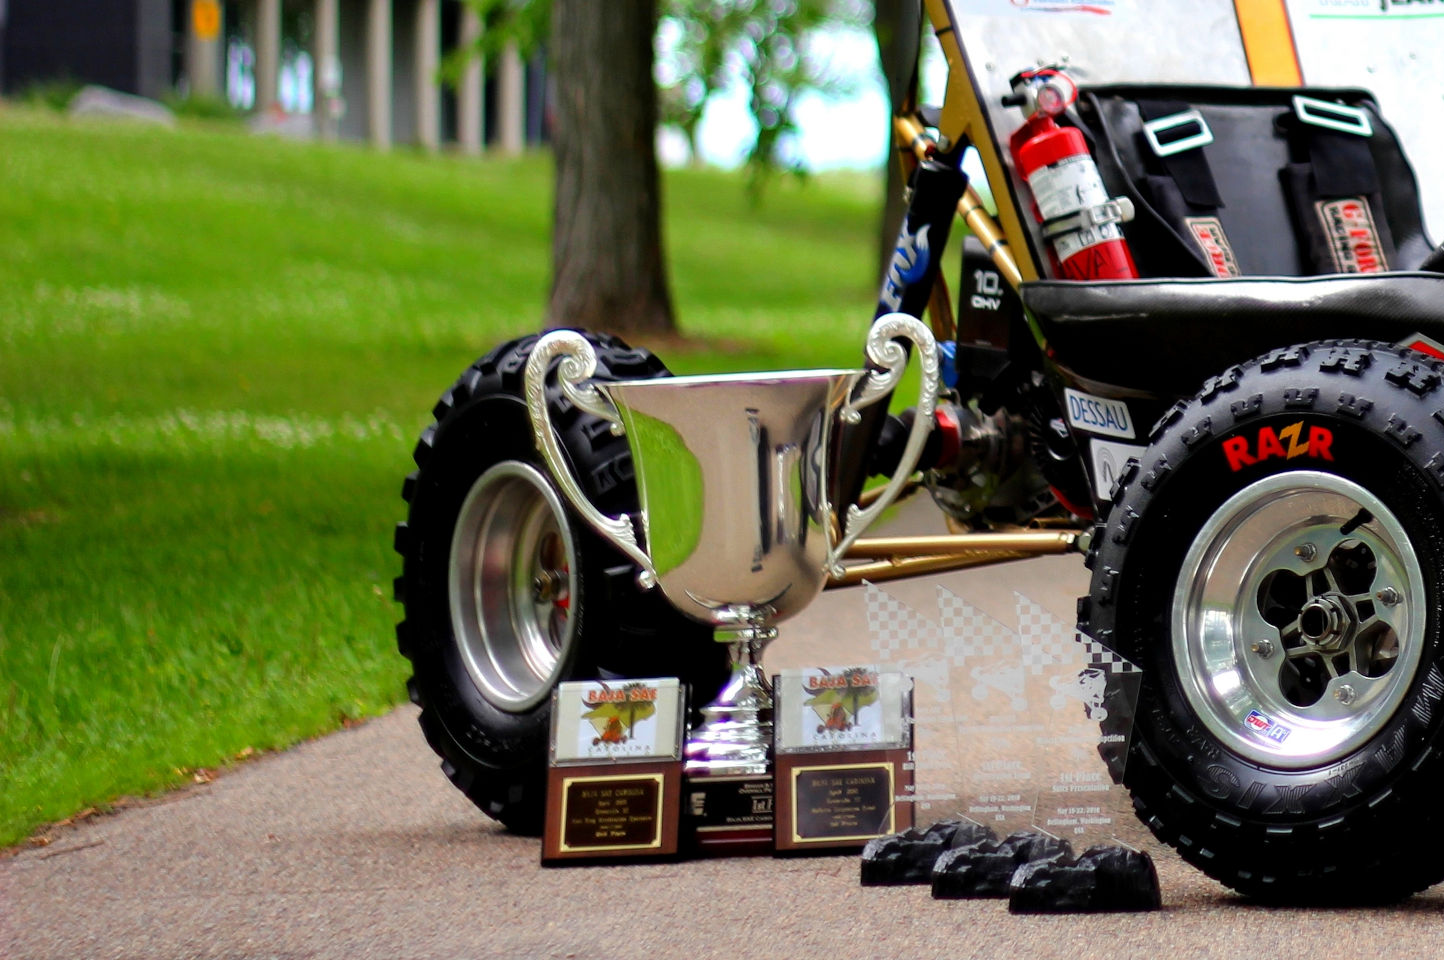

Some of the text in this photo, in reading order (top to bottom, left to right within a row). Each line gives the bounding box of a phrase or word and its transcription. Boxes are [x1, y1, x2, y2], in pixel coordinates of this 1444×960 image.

[880, 217, 920, 313] FOX
[1069, 395, 1128, 432] DESSAU
[1222, 420, 1336, 473] RAZR
[588, 688, 658, 702] BAJA SAE
[809, 676, 847, 689] BAJA
